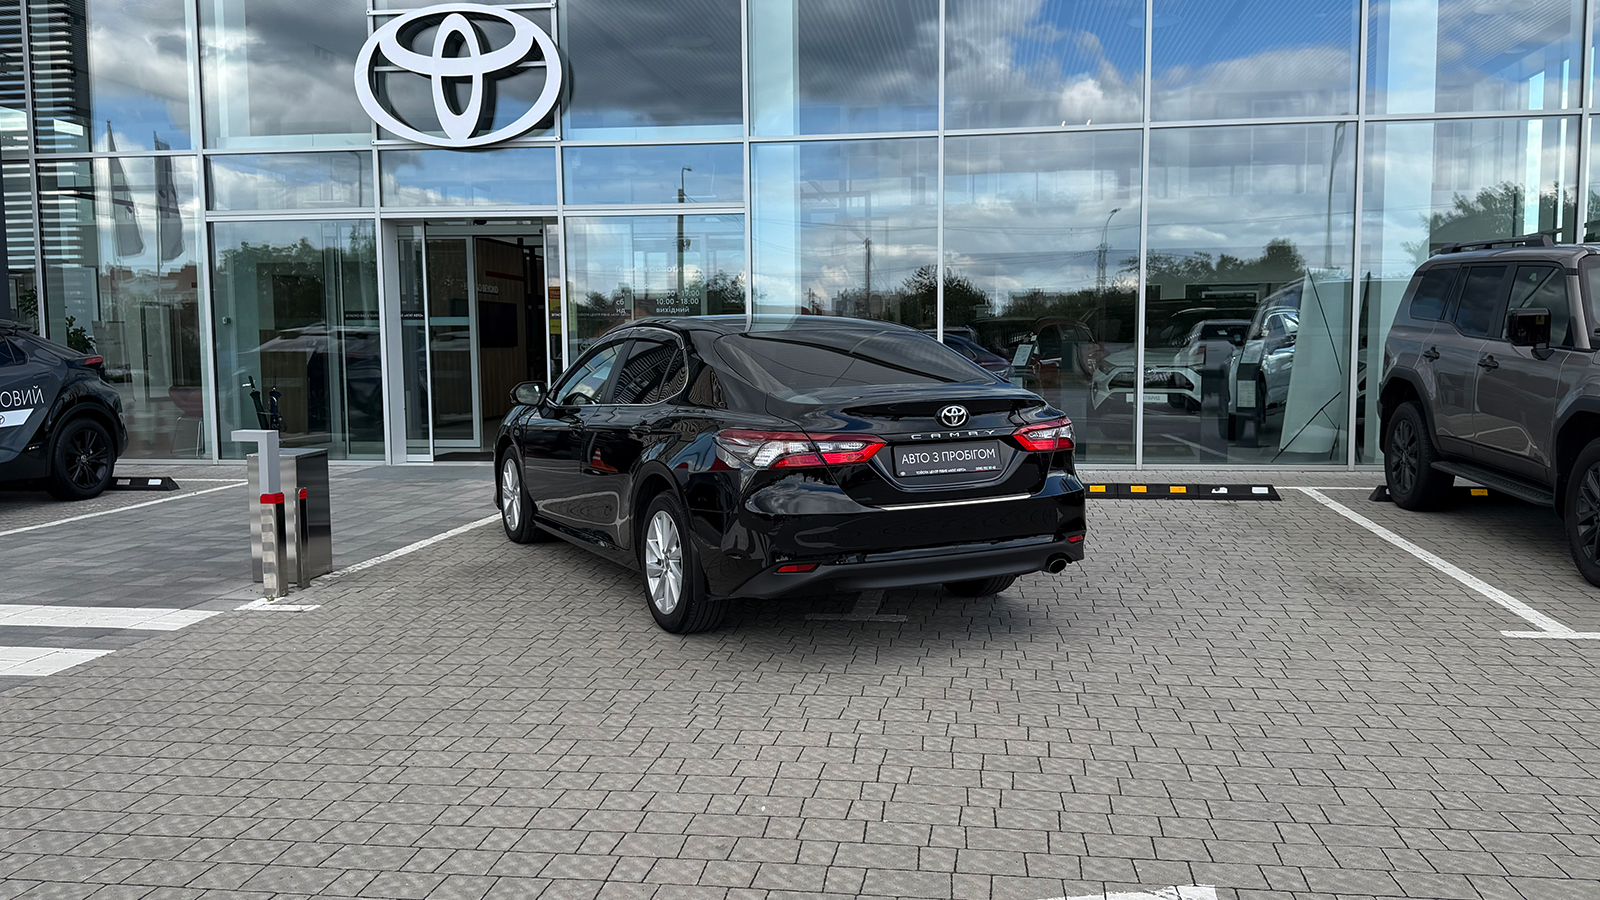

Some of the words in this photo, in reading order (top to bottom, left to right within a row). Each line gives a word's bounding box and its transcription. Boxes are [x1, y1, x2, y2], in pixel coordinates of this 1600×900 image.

[911, 430, 995, 440] CAMRY
[902, 452, 930, 464] АВТО
[942, 448, 996, 462] ПРОБІГОМ
